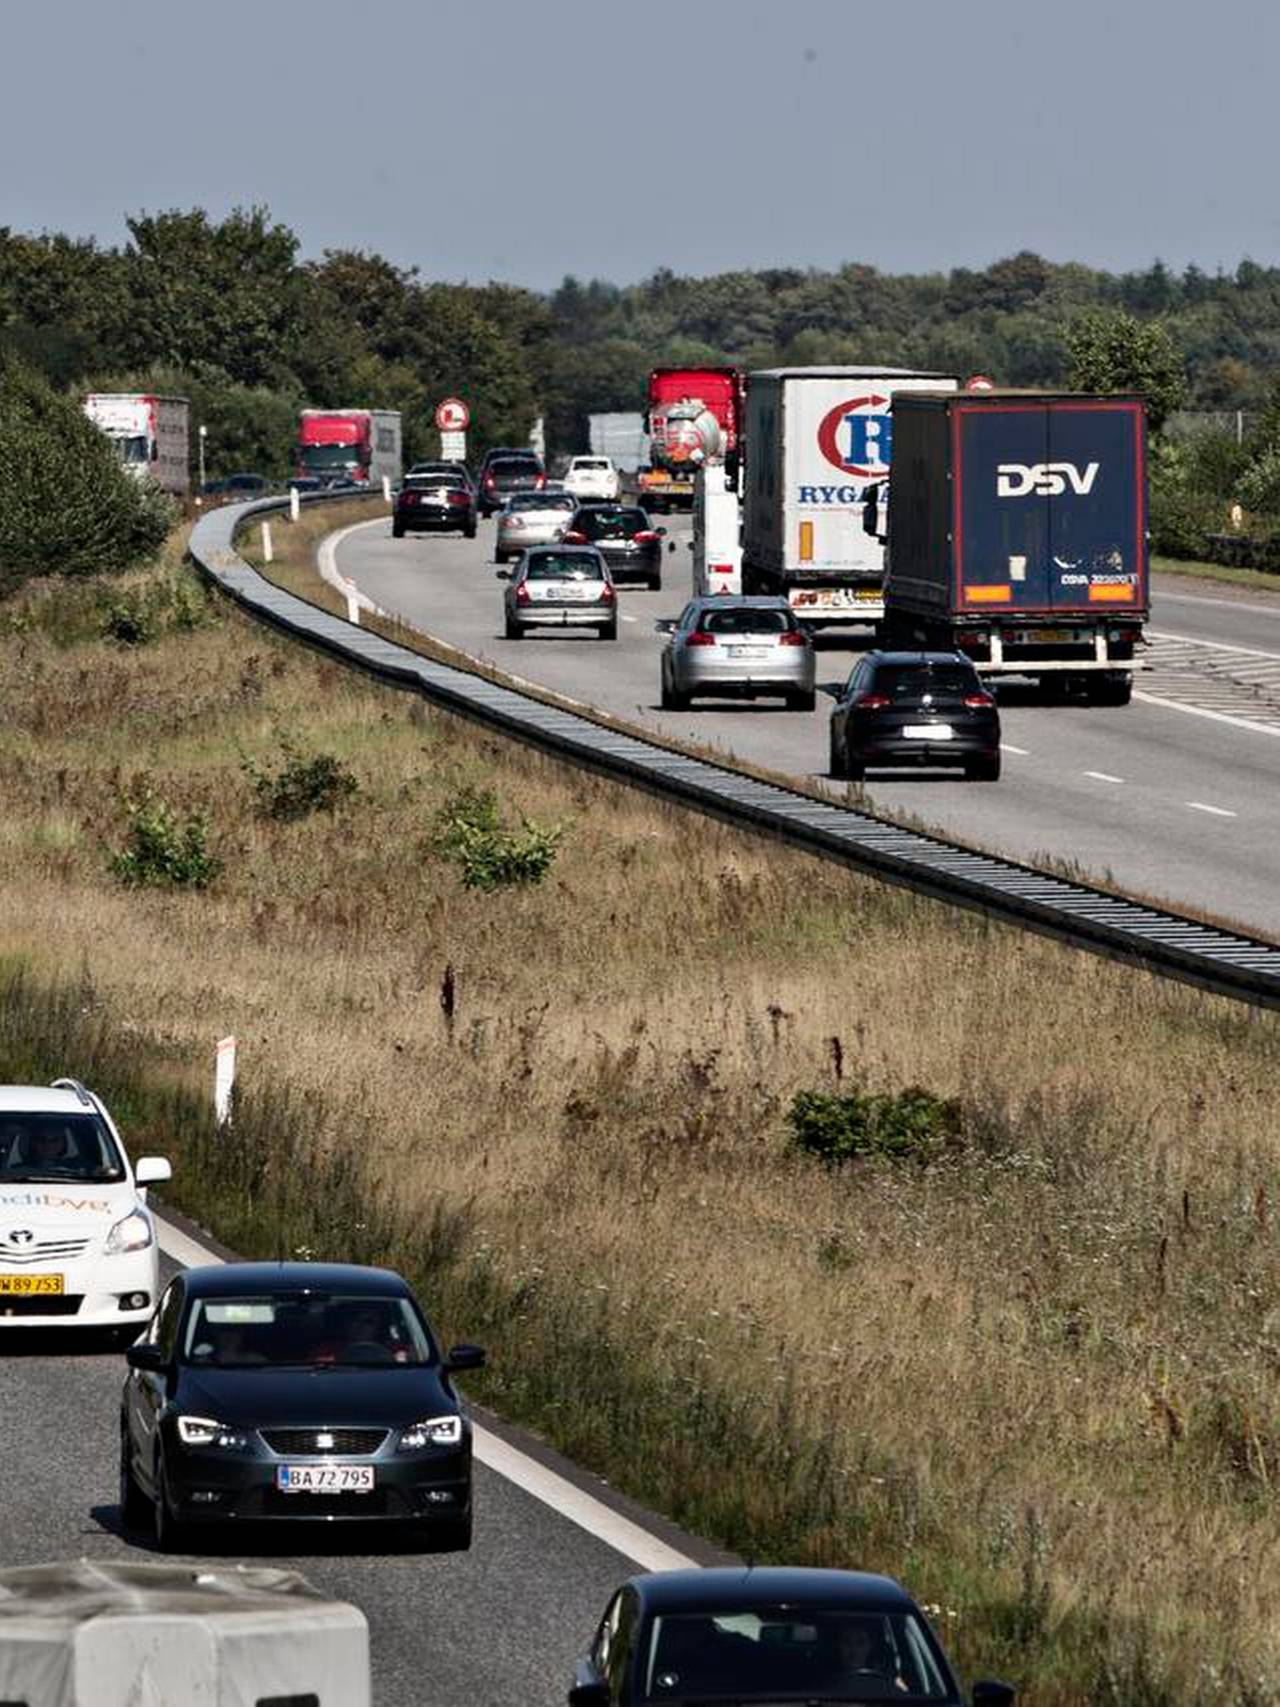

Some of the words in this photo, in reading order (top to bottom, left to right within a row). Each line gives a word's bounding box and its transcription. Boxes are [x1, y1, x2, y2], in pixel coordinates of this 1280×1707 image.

[997, 462, 1100, 497] DSV
[13, 1276, 32, 1293] 89
[35, 1276, 61, 1293] 753
[290, 1470, 313, 1486] BA
[317, 1470, 337, 1486] 72
[341, 1469, 371, 1486] 795
